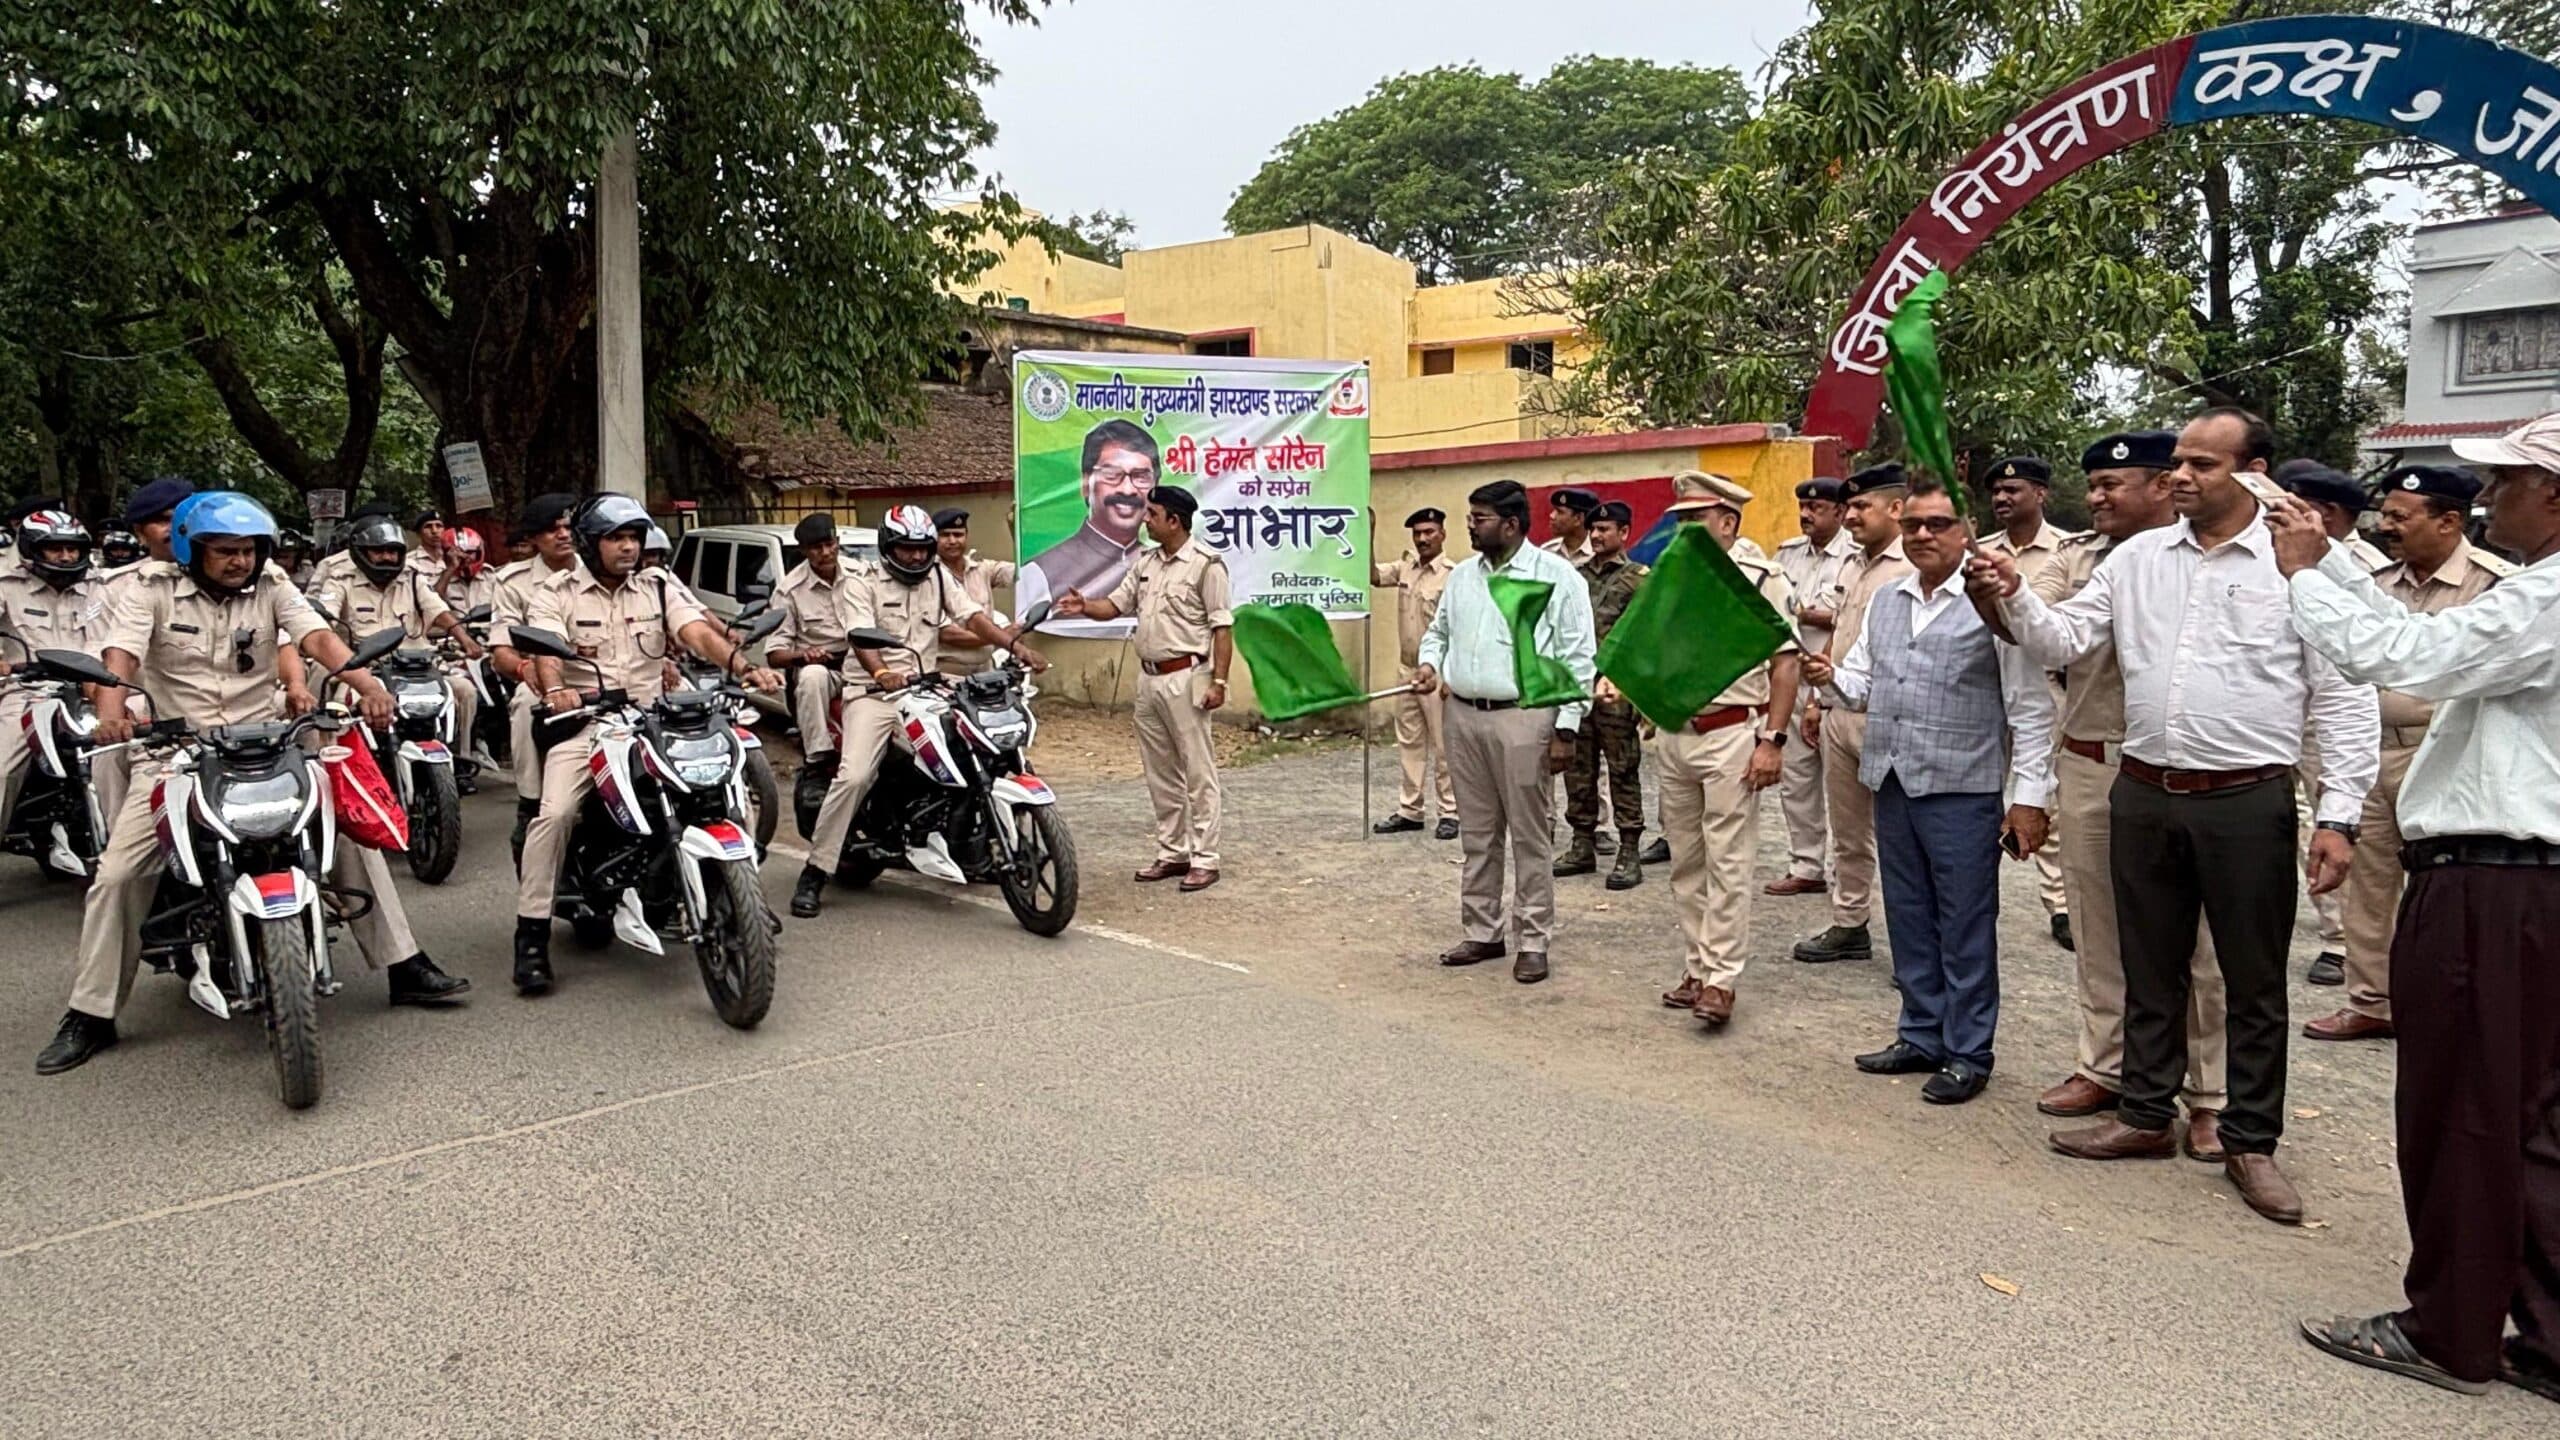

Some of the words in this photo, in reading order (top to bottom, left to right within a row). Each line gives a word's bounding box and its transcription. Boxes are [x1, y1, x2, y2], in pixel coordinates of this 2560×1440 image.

[1931, 63, 2157, 235] नियंत्रण
[1076, 373, 1136, 411] माननीय
[1141, 376, 1205, 426] मुख्यमंत्री
[1210, 388, 1270, 418] झारखण्ड
[1165, 434, 1196, 473] श्री
[1204, 437, 1257, 478] हेमंत
[1264, 433, 1326, 472] सोरेन
[1238, 475, 1261, 497] को
[1266, 477, 1311, 498] सप्रेम
[1200, 505, 1359, 557] आभार
[1319, 588, 1363, 609] पुलिस
